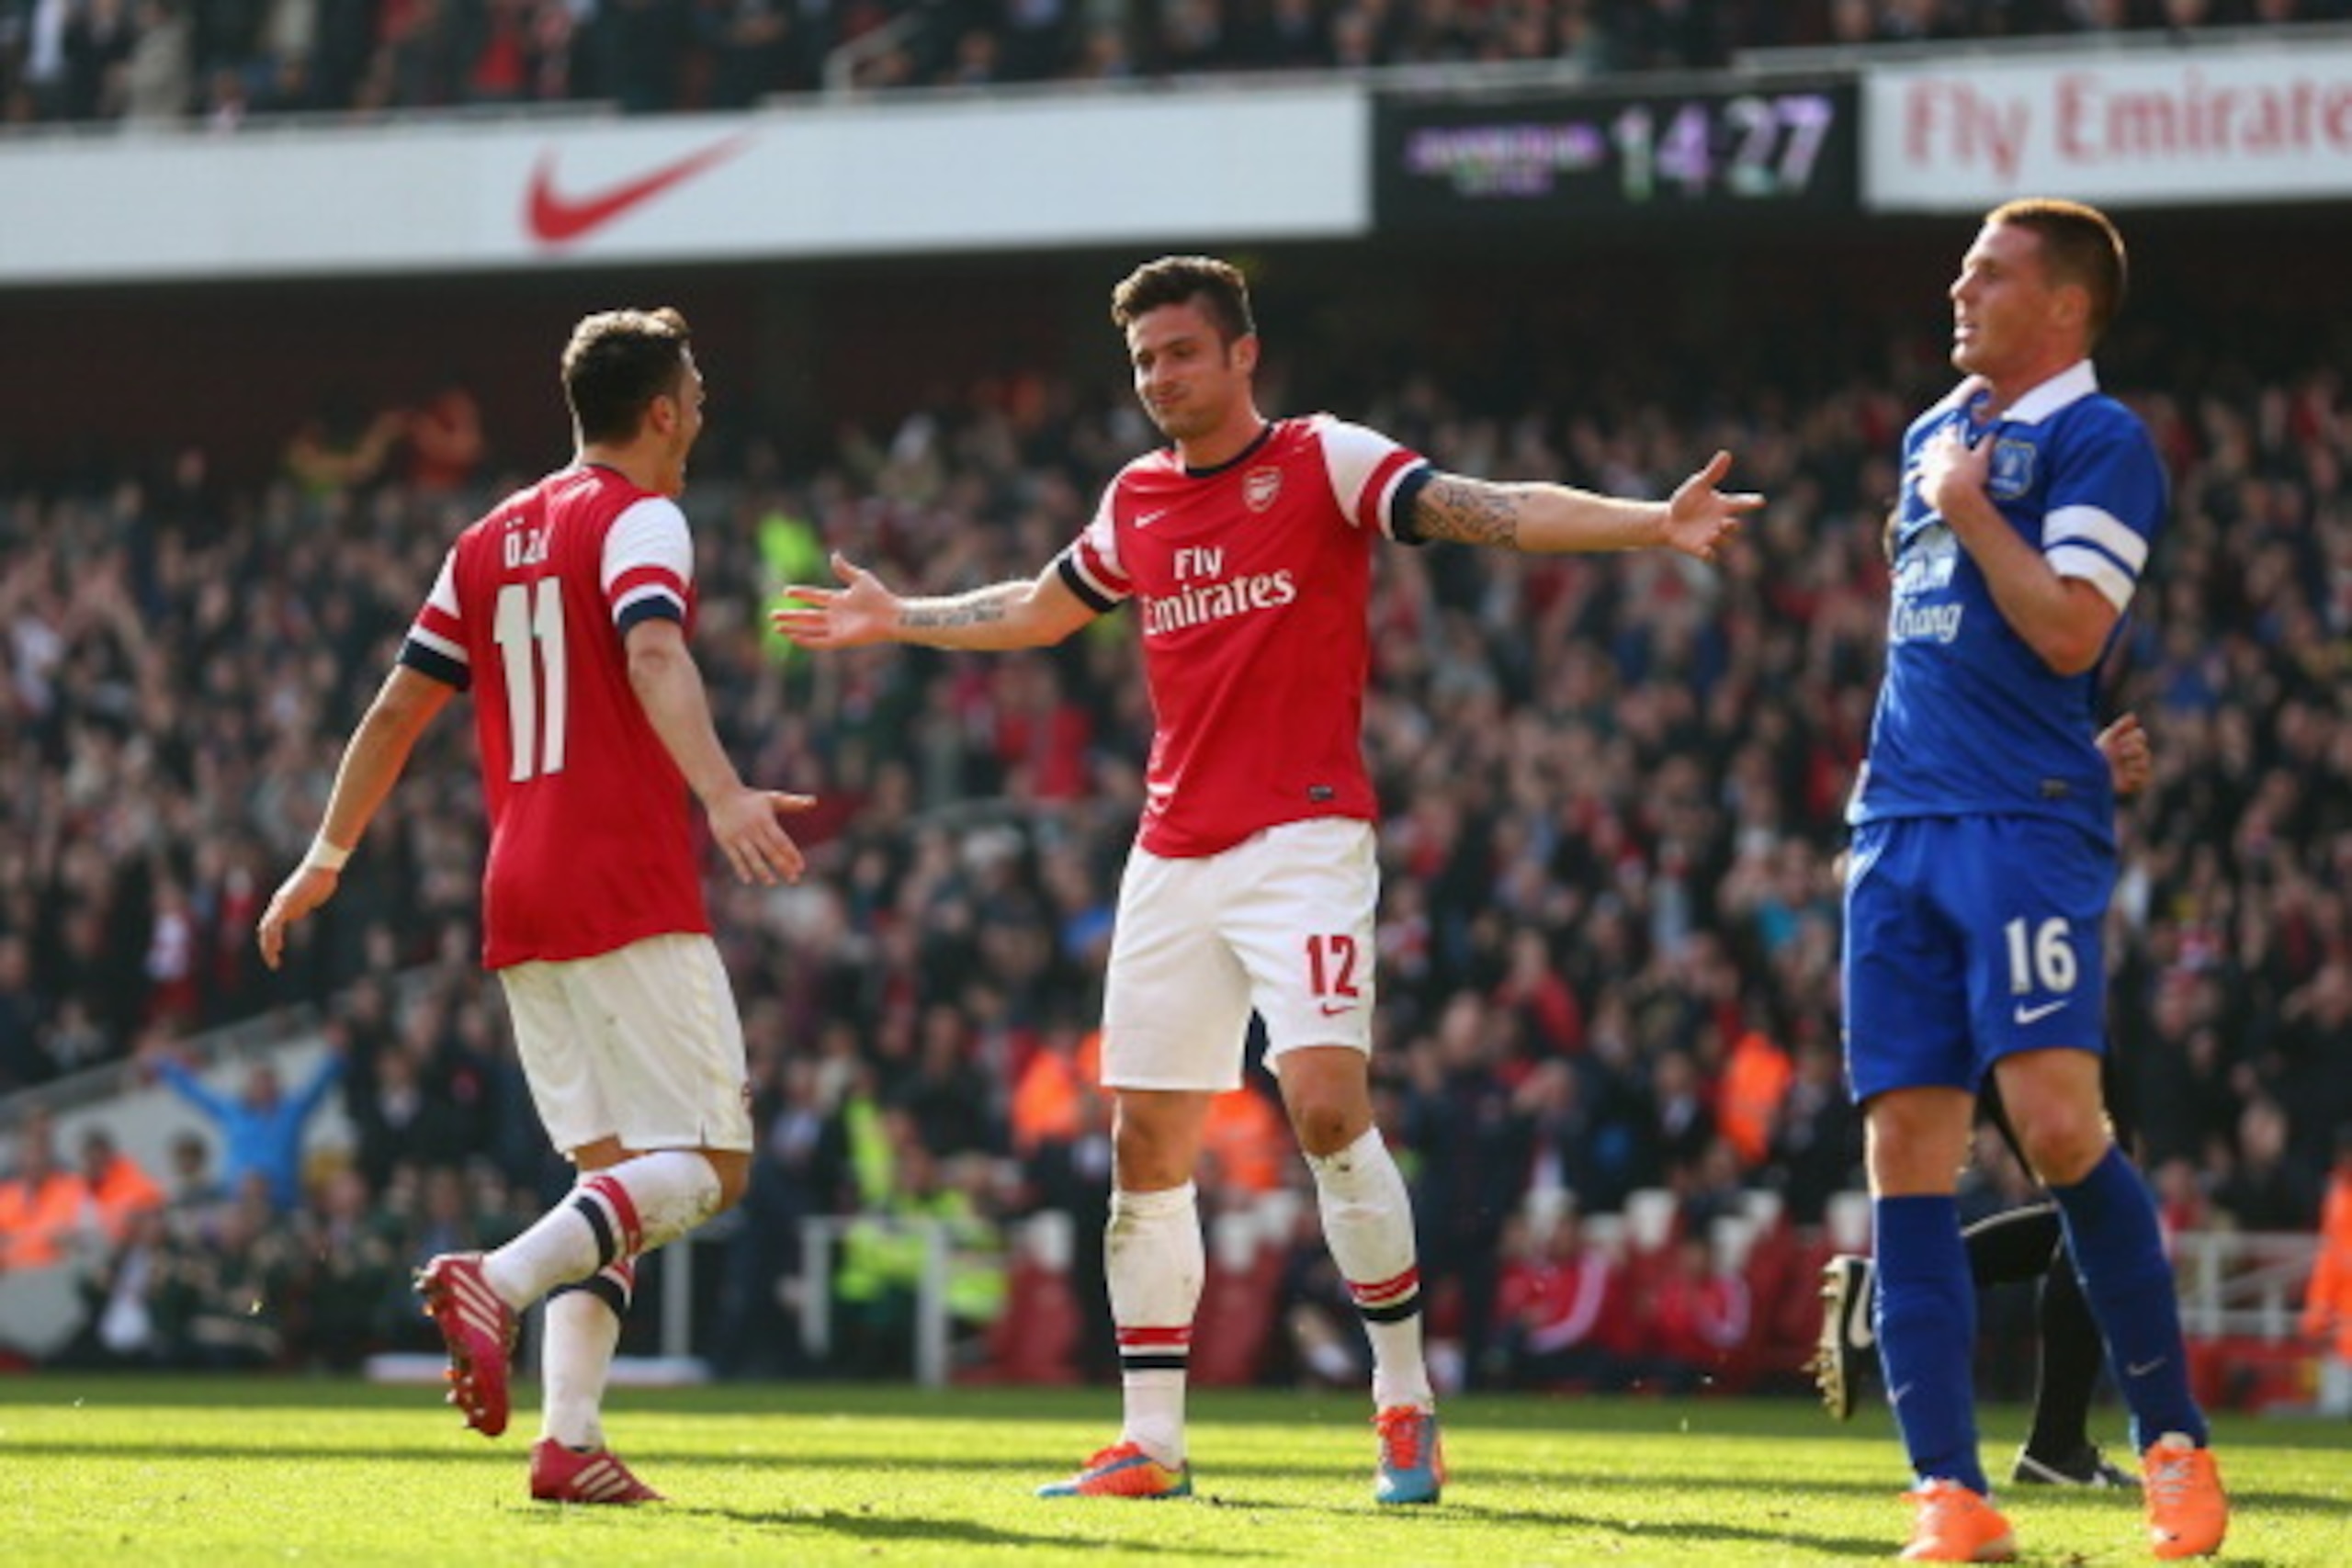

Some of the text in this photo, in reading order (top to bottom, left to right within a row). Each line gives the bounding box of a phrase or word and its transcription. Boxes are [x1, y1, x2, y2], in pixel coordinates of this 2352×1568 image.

[1905, 79, 2028, 186] Fly
[1174, 547, 1222, 581] Fly
[1144, 570, 1296, 635] Emirates
[494, 576, 565, 782] 11
[1306, 935, 1358, 998] 12
[2004, 917, 2076, 995] 16
